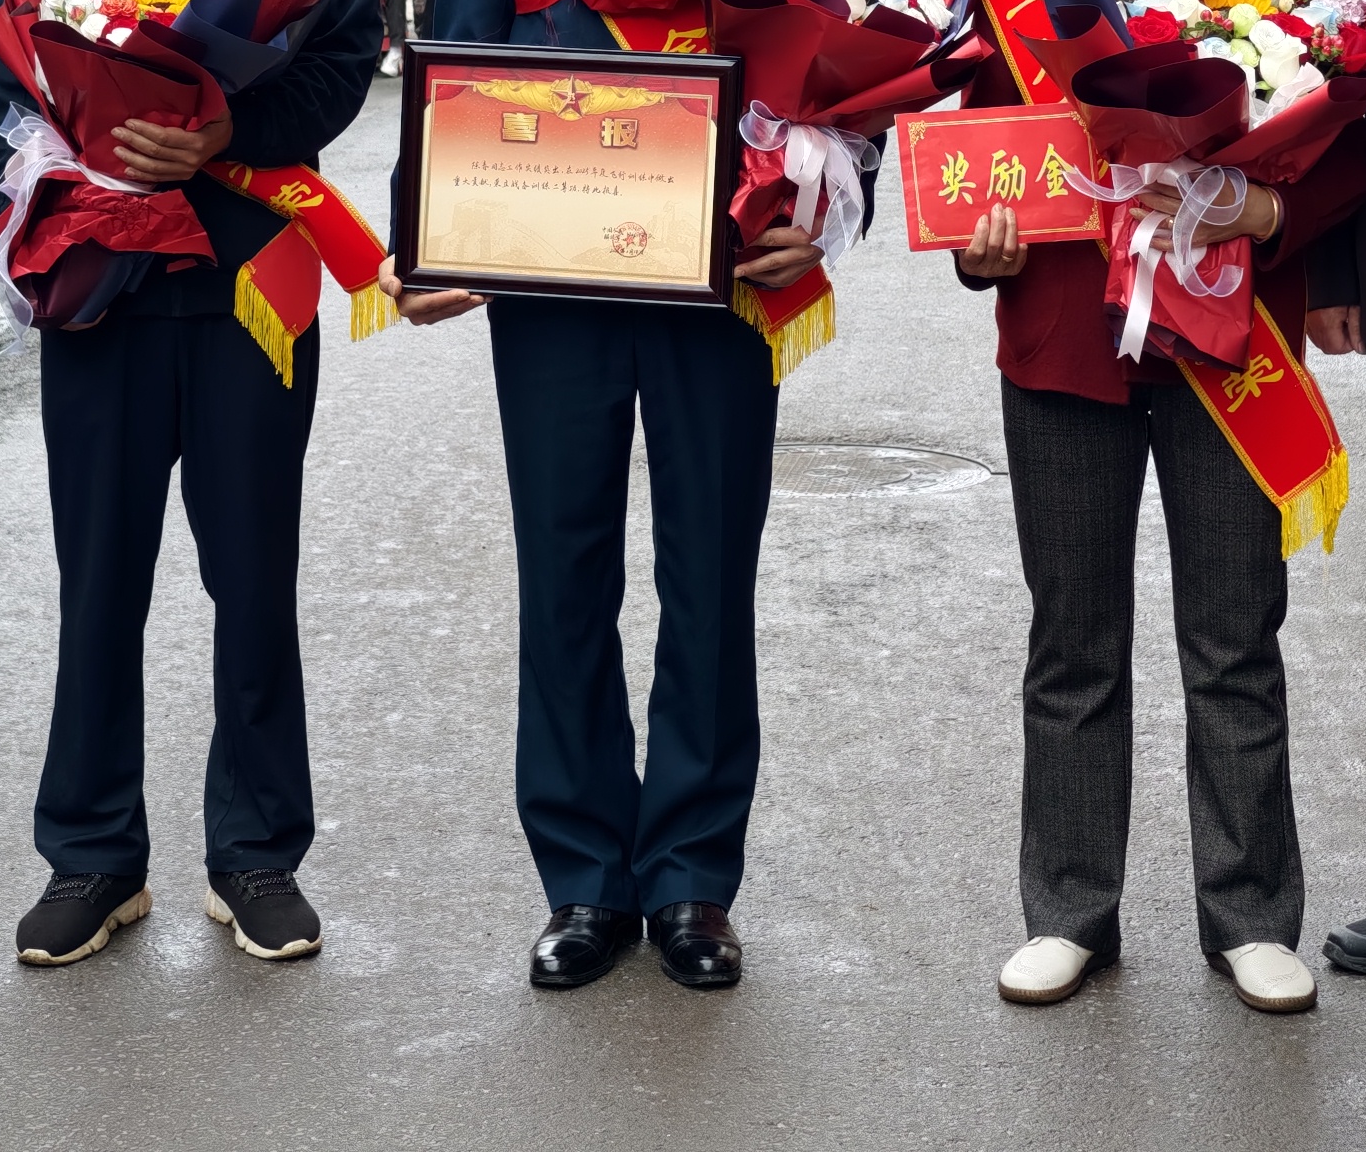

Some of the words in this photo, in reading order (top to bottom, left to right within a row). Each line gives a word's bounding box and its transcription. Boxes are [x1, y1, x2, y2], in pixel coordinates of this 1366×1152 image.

[501, 112, 639, 149] 喜报
[938, 143, 1074, 206] 奖励金
